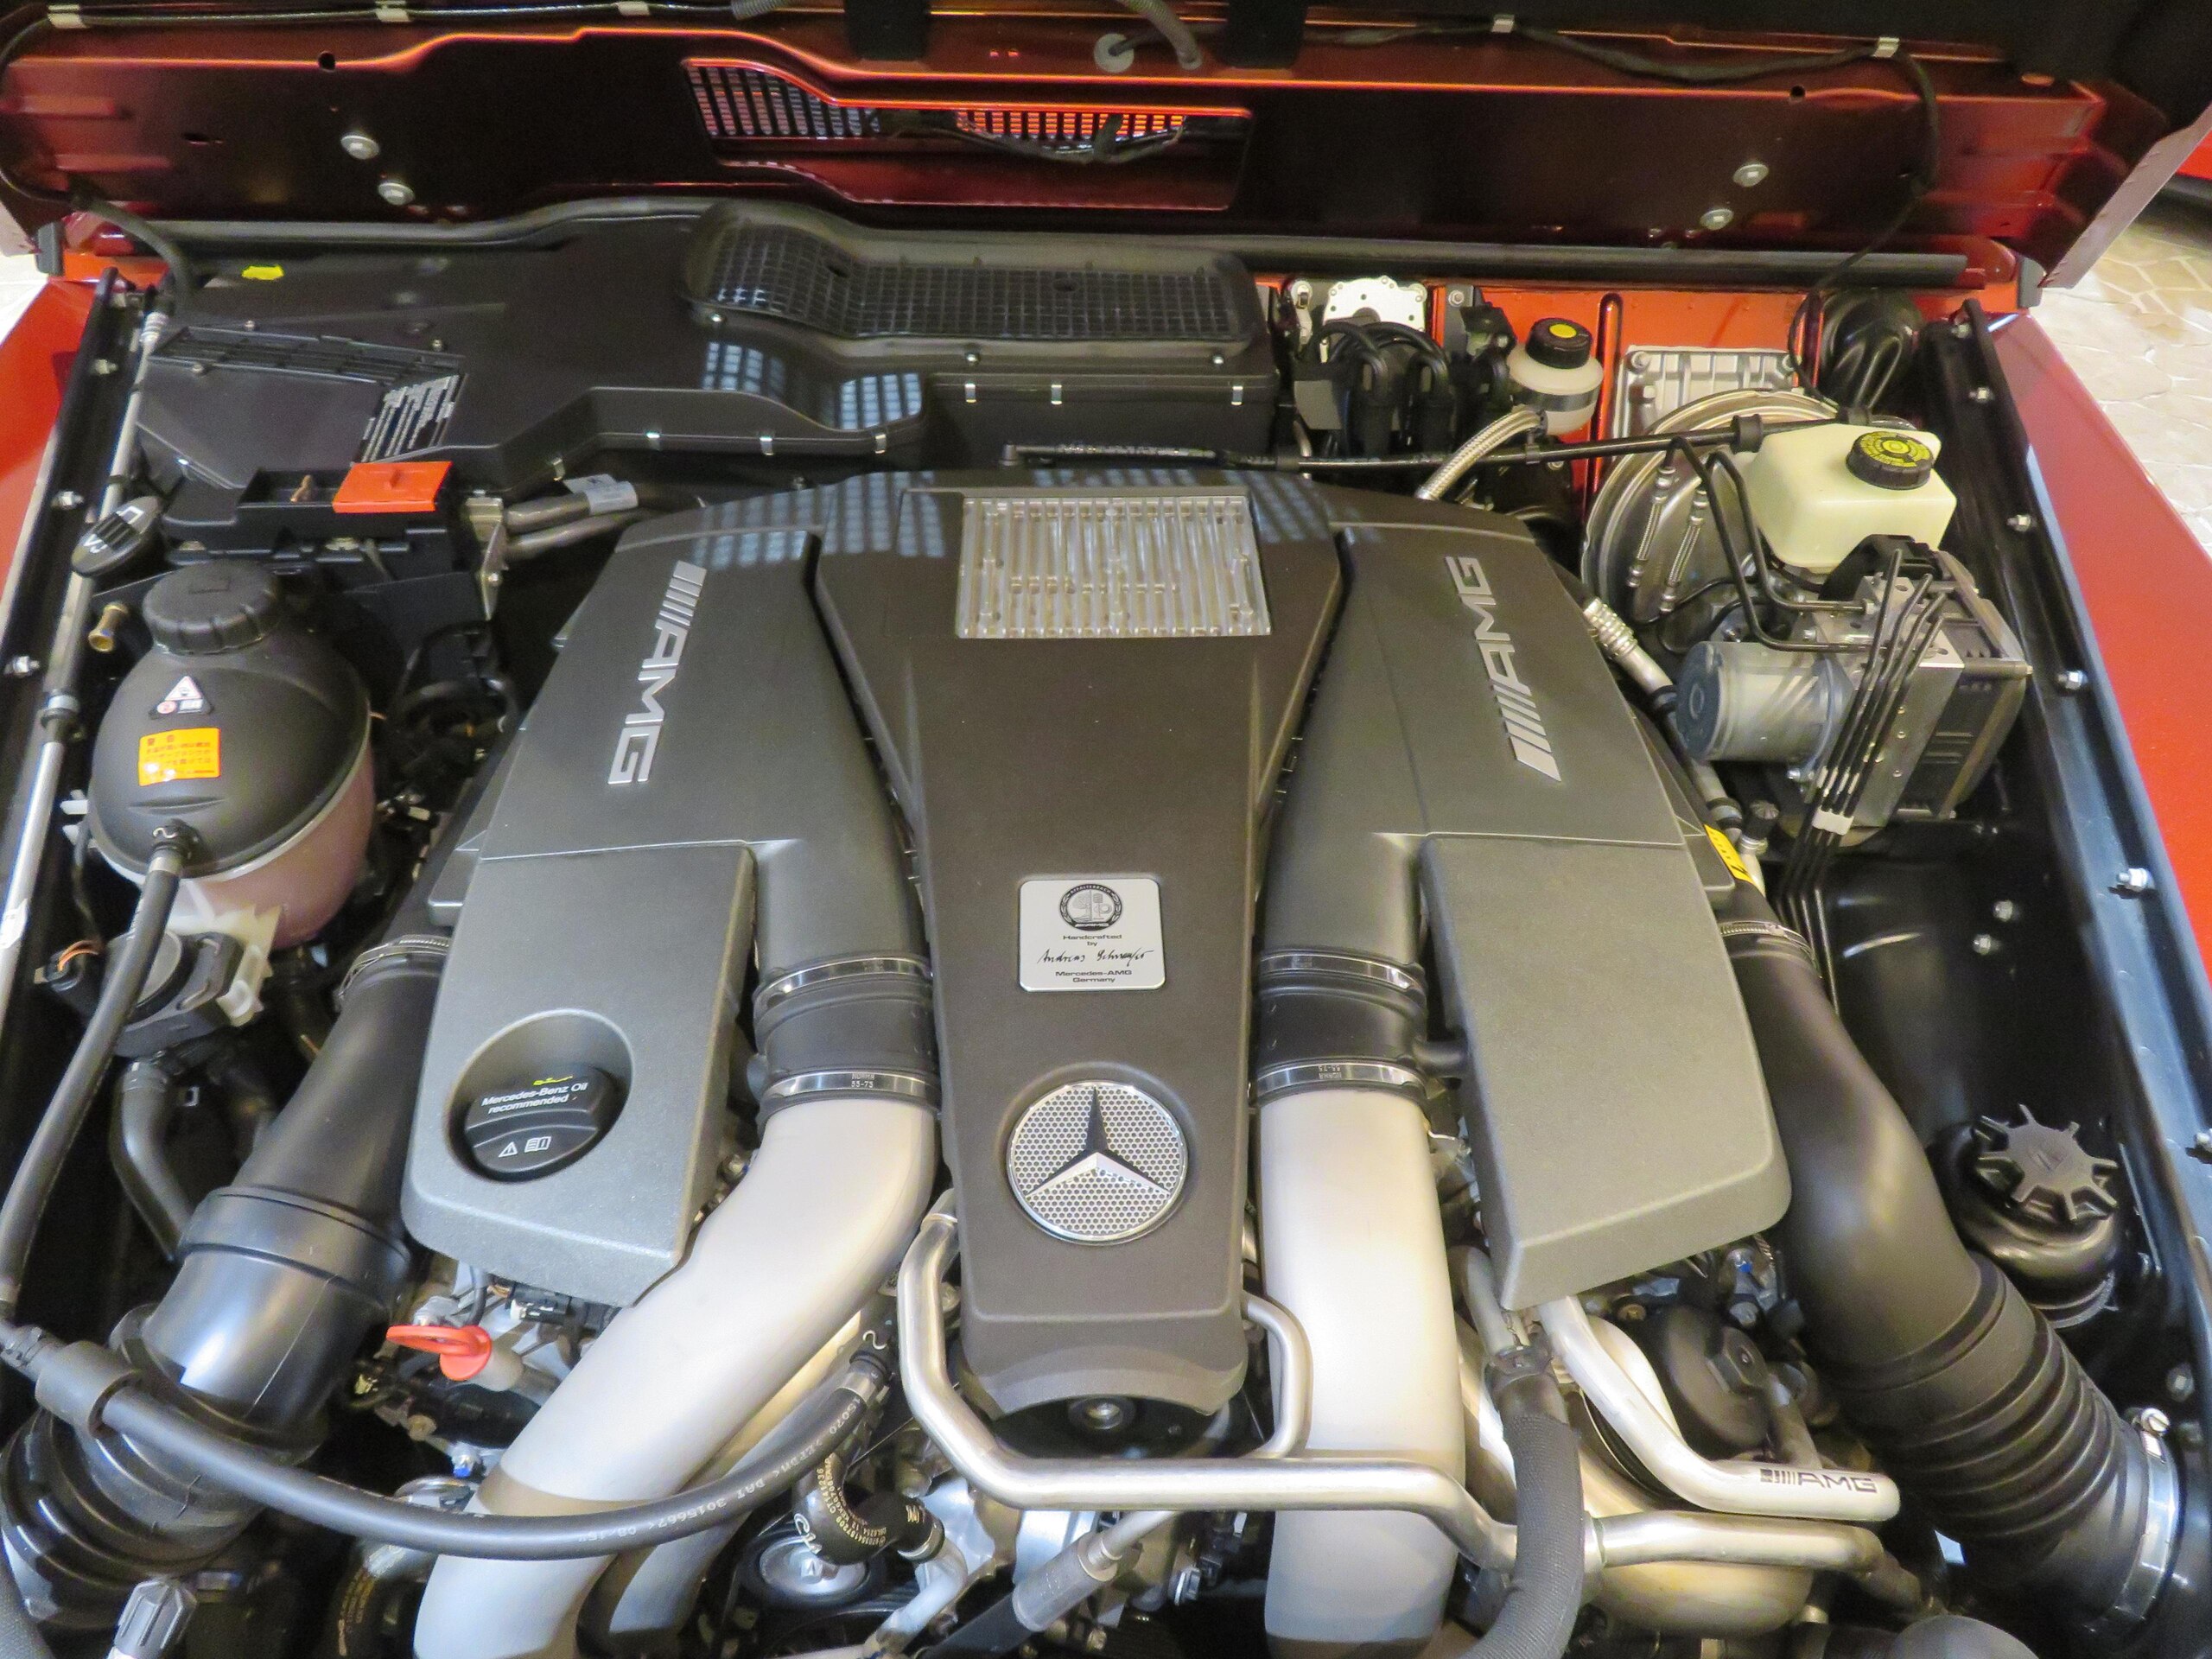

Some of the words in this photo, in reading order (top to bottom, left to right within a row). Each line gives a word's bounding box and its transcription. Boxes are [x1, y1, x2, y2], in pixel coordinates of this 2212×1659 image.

[607, 618, 690, 785] AMG
[481, 1085, 569, 1106] Mercedes-Benz
[570, 1082, 588, 1092] Oil
[488, 1094, 569, 1115] recommended
[1798, 1471, 1878, 1493] AMG
